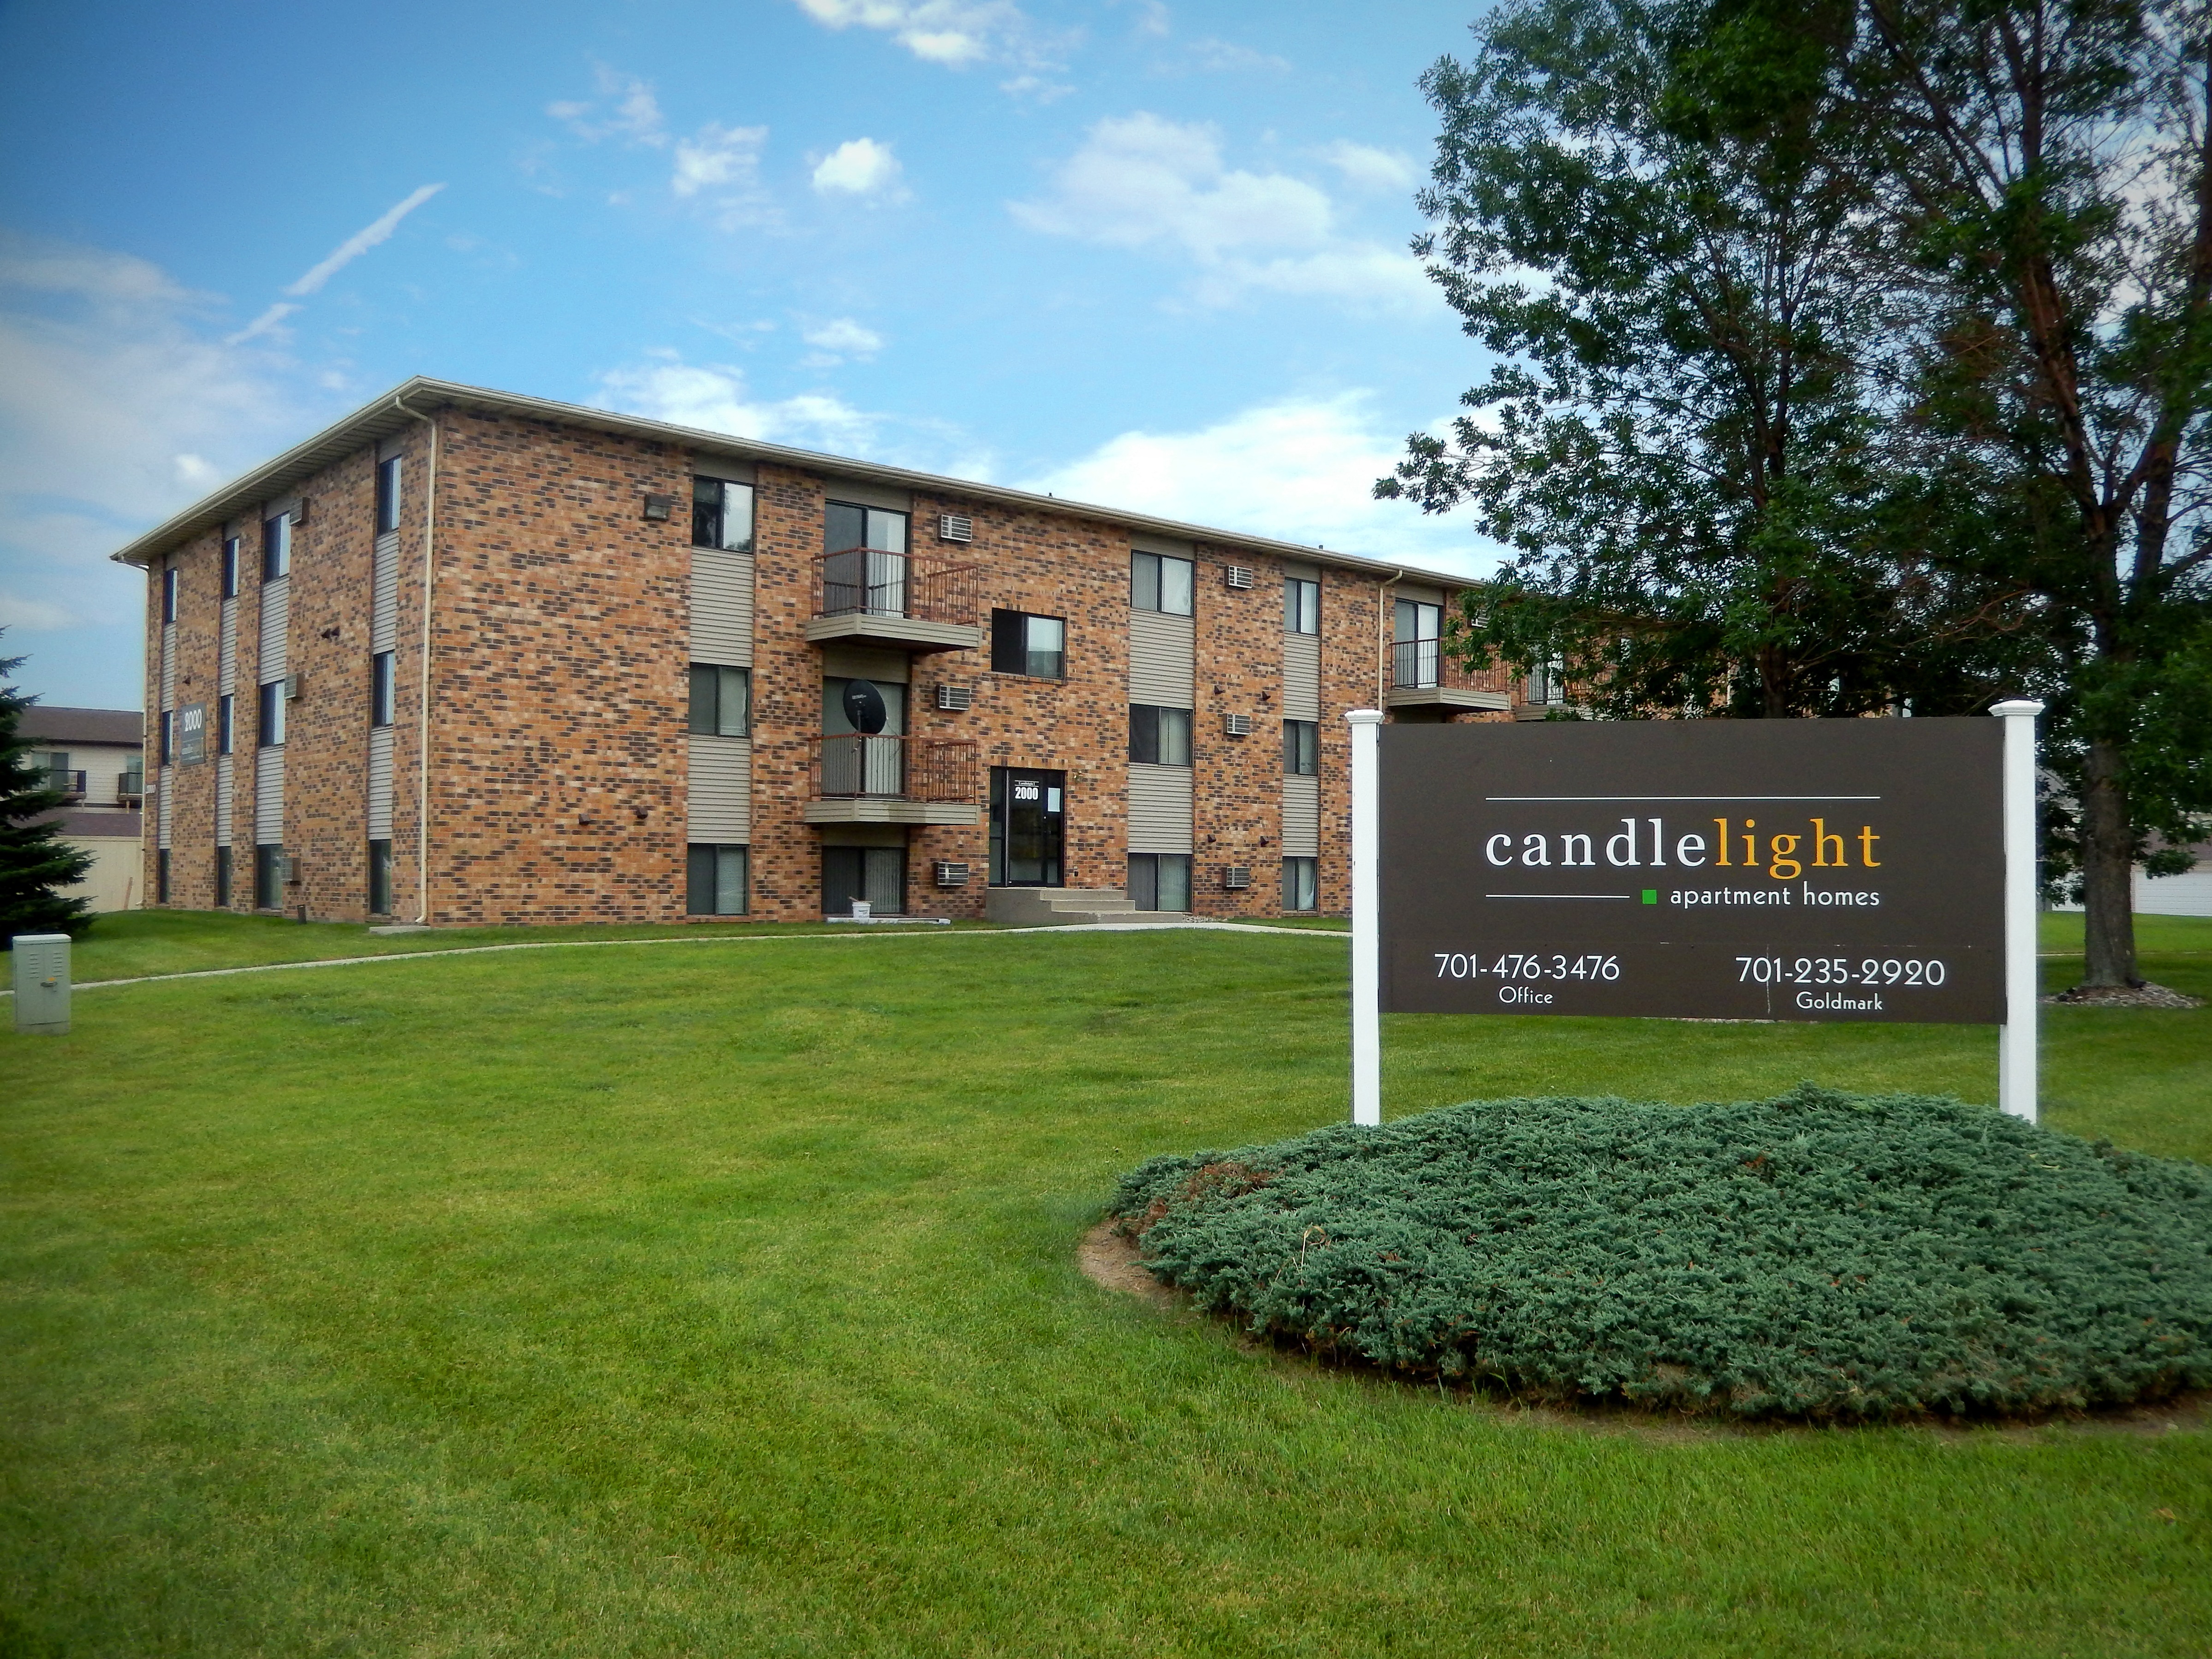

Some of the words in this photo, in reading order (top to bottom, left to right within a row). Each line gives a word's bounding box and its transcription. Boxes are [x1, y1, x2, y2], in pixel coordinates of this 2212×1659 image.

[184, 709, 202, 732] 2000
[1015, 786, 1038, 800] 2000
[1486, 818, 1881, 880] candlelight
[1670, 886, 1791, 910] apartment
[1803, 880, 1880, 906] homes
[1434, 953, 1620, 981] 701-476-3476
[1735, 956, 1945, 986] 701-235-2920
[1498, 985, 1553, 1004] Office
[1796, 990, 1883, 1010] Goldmark
